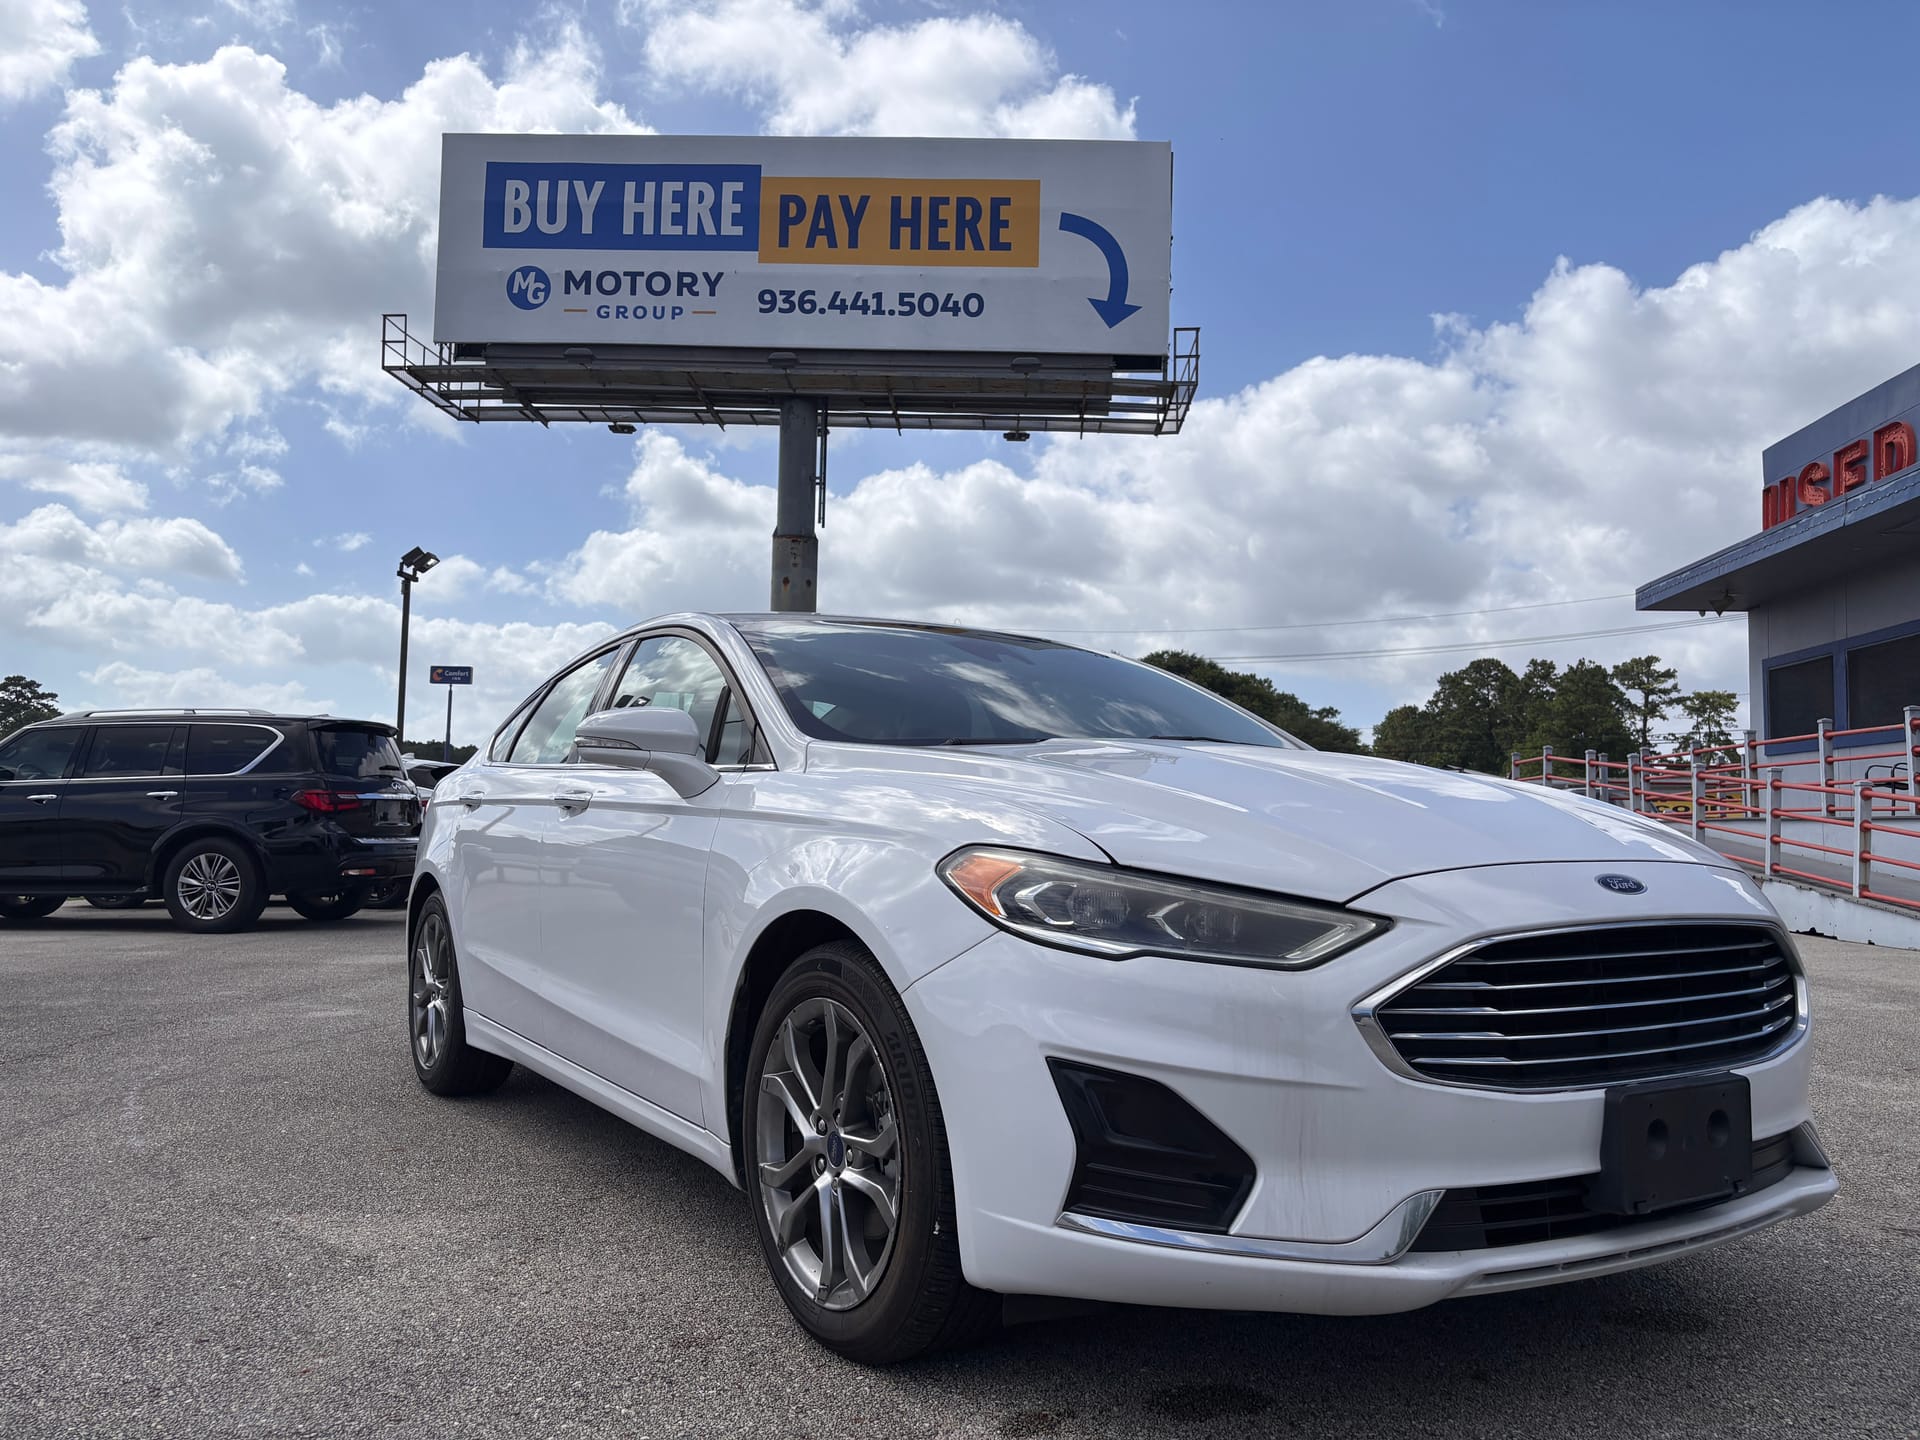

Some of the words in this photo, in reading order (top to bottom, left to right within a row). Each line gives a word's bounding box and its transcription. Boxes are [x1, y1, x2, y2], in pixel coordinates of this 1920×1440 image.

[503, 179, 606, 235] BUY
[622, 181, 745, 236] HERE
[778, 194, 871, 249] PAY
[889, 196, 1012, 251] HERE
[512, 271, 546, 305] MG
[563, 270, 725, 297] MOTORY
[596, 304, 684, 320] GROUP
[757, 289, 985, 318] 936.441.5040
[1763, 421, 1917, 532] USED
[1606, 878, 1638, 890] Ford
